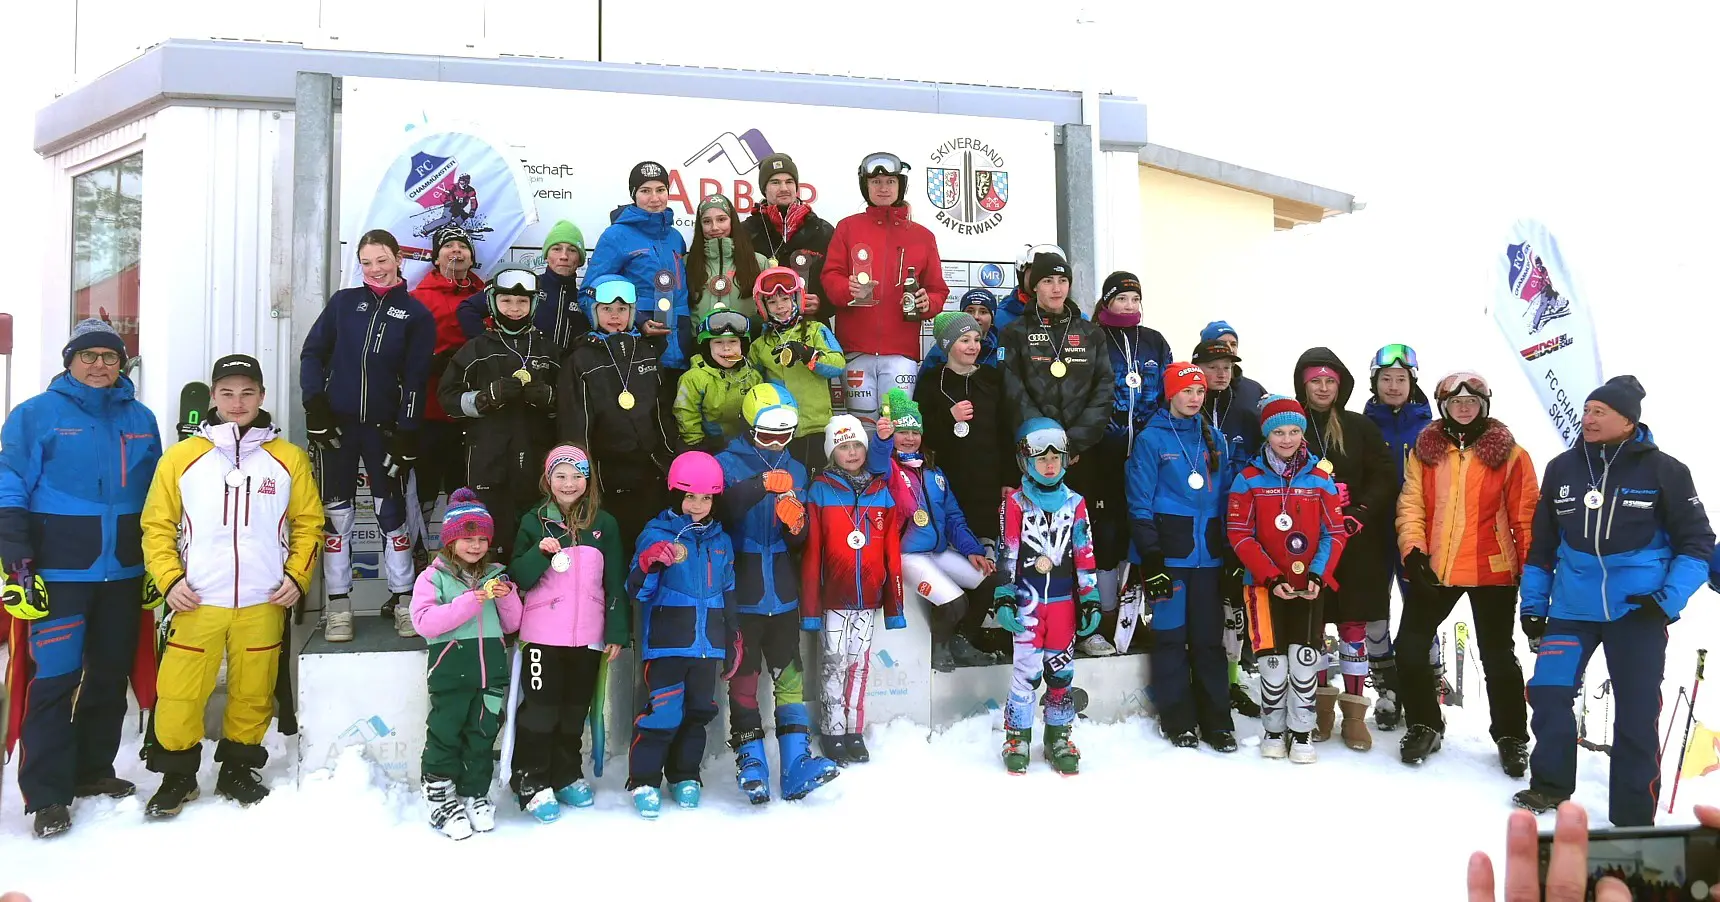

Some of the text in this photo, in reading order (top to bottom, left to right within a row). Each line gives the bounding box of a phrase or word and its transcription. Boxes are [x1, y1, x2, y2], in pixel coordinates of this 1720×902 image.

[930, 137, 1004, 168] SKIVERBAND
[415, 160, 433, 177] FC
[935, 210, 1003, 235] BAYERWALD
[1512, 251, 1525, 272] FC
[982, 270, 1000, 280] MR
[1545, 369, 1558, 391] FC
[1549, 403, 1572, 442] SKI &
[834, 436, 844, 444] Red
[529, 648, 543, 691] POC
[889, 688, 908, 696] Wald
